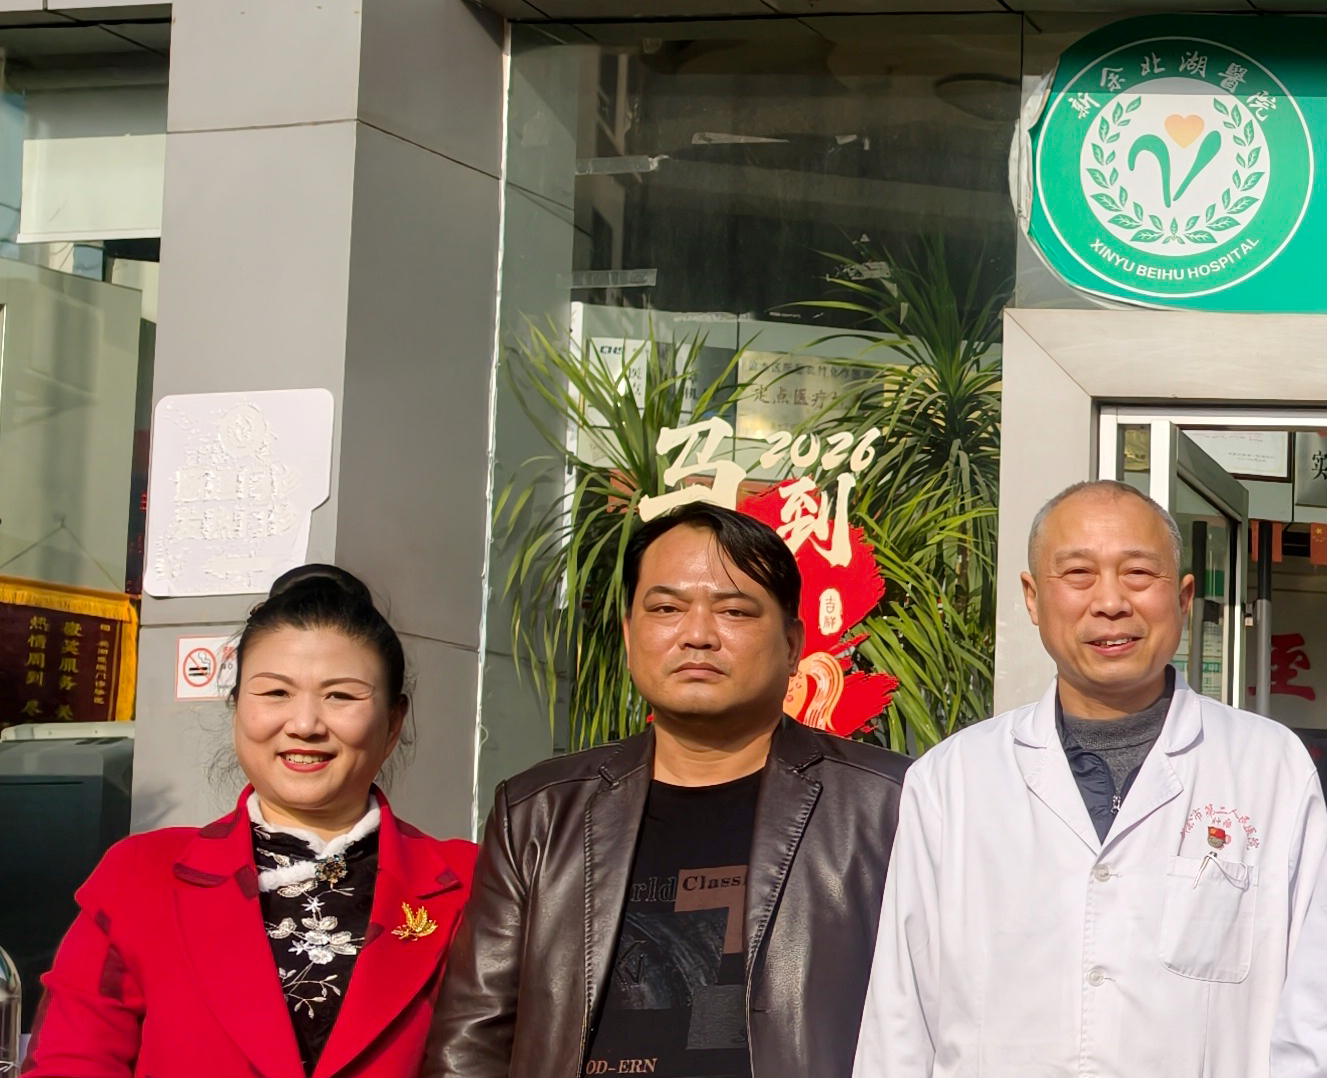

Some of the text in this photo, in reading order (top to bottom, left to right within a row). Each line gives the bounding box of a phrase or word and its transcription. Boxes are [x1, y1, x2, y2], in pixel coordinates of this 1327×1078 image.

[1089, 236, 1260, 280] XINYU BEIHU HOSPITAL
[760, 427, 882, 472] 2026
[682, 872, 746, 893] Class
[585, 1057, 658, 1075] OD-ERN
